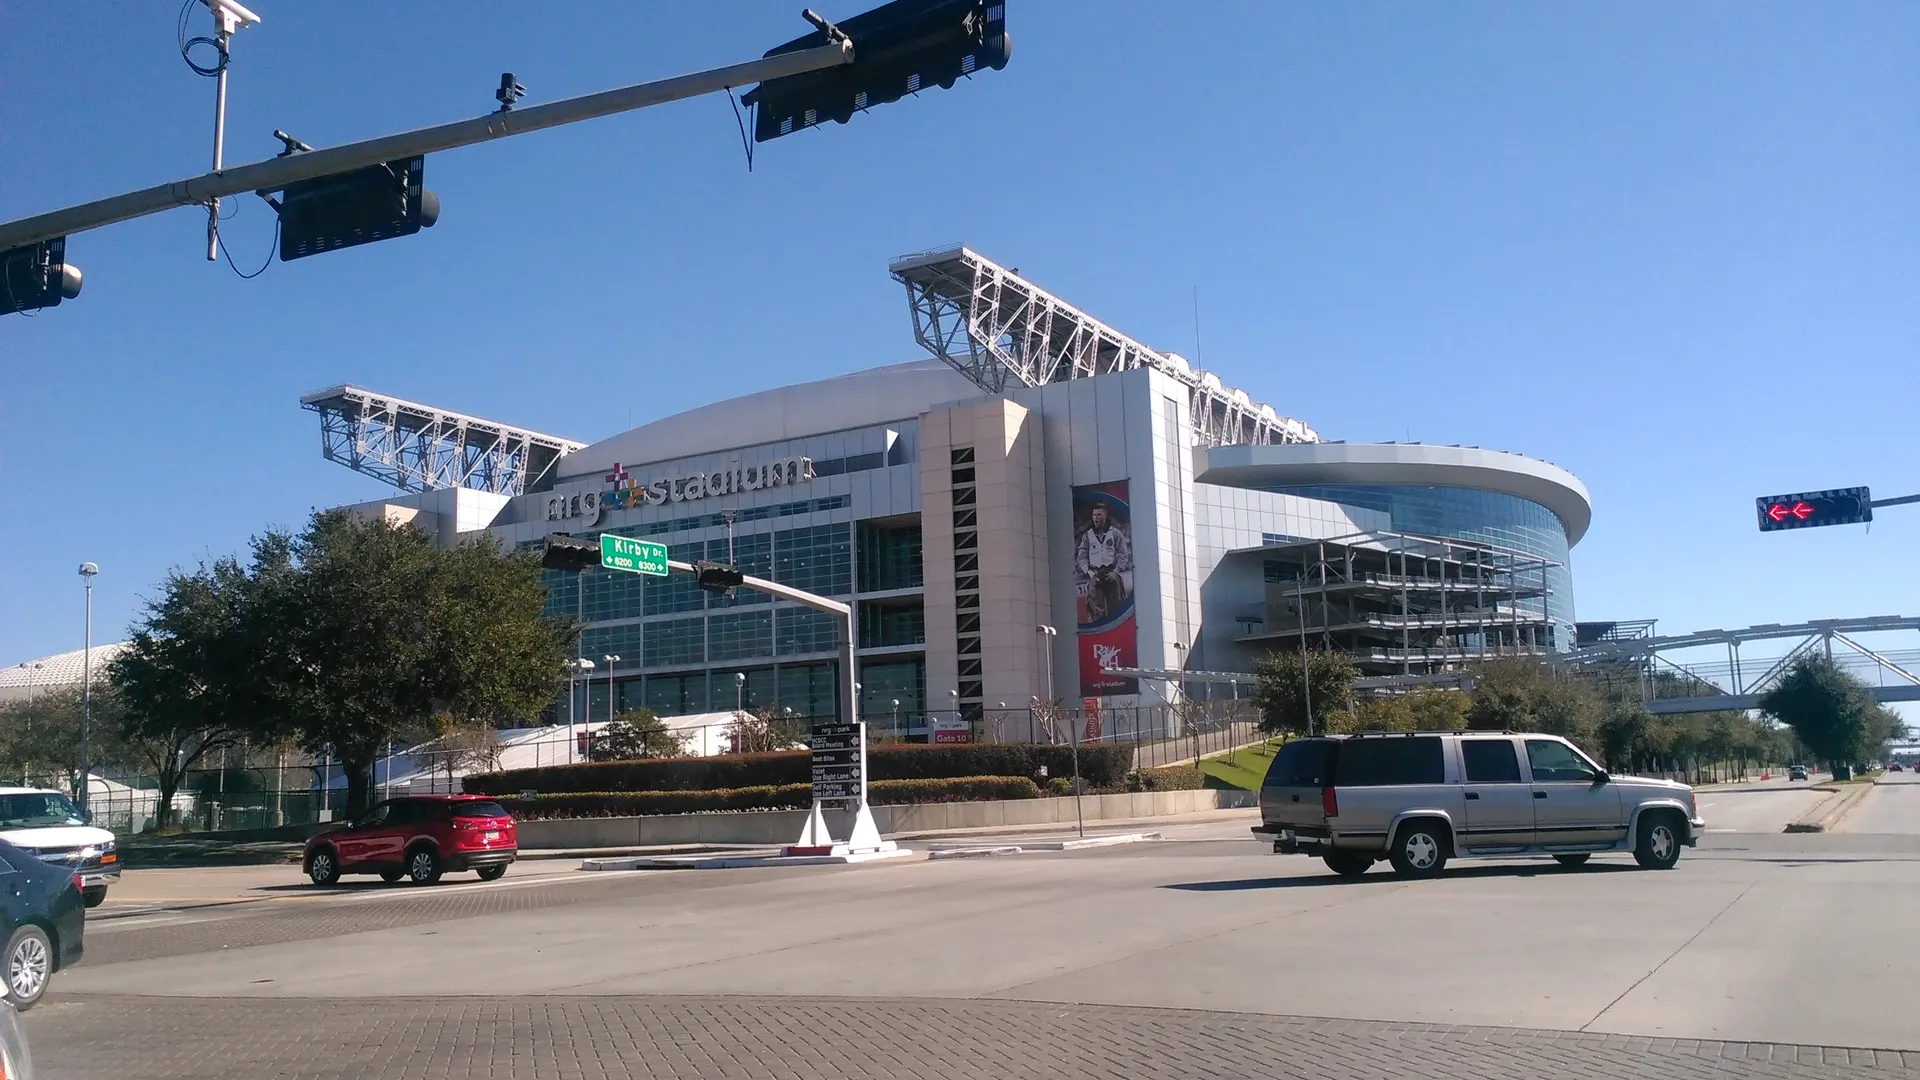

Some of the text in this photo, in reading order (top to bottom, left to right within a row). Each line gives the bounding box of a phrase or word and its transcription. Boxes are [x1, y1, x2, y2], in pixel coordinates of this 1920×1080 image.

[647, 456, 807, 506] stadium
[615, 540, 664, 559] Kirby Dr.
[614, 557, 656, 571] 8200 8300
